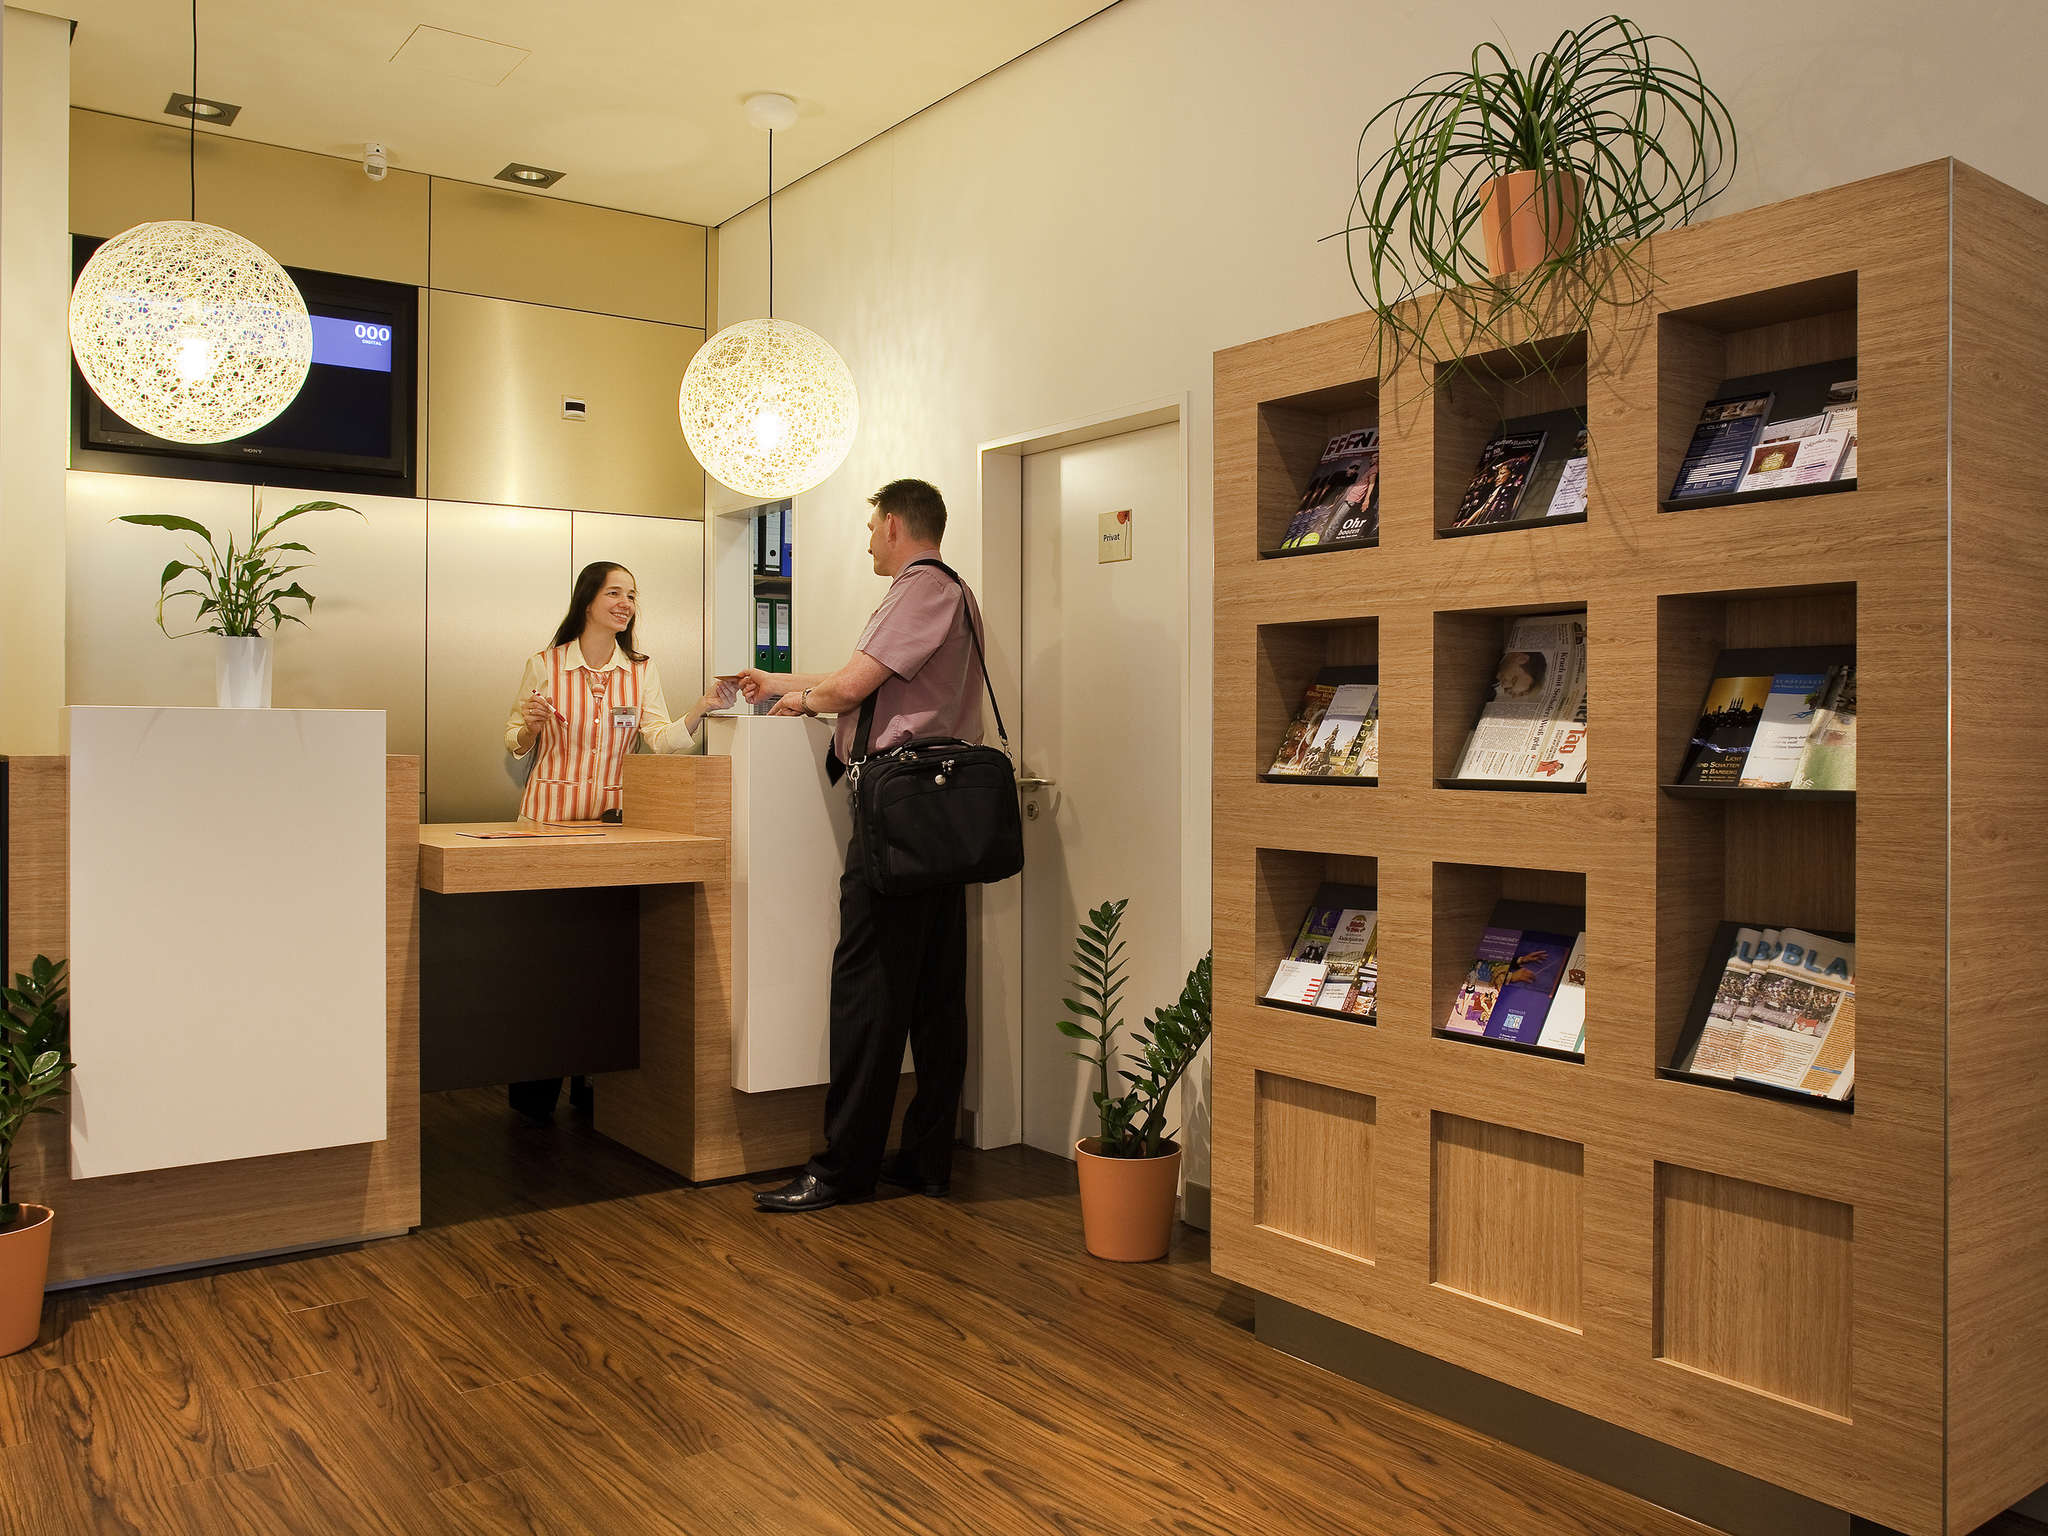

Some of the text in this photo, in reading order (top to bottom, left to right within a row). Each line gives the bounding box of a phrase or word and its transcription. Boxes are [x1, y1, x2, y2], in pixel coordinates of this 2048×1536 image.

[354, 324, 390, 341] 000
[1342, 517, 1367, 530] Ohr
[1103, 533, 1121, 543] Privat
[1559, 728, 1588, 755] Tag
